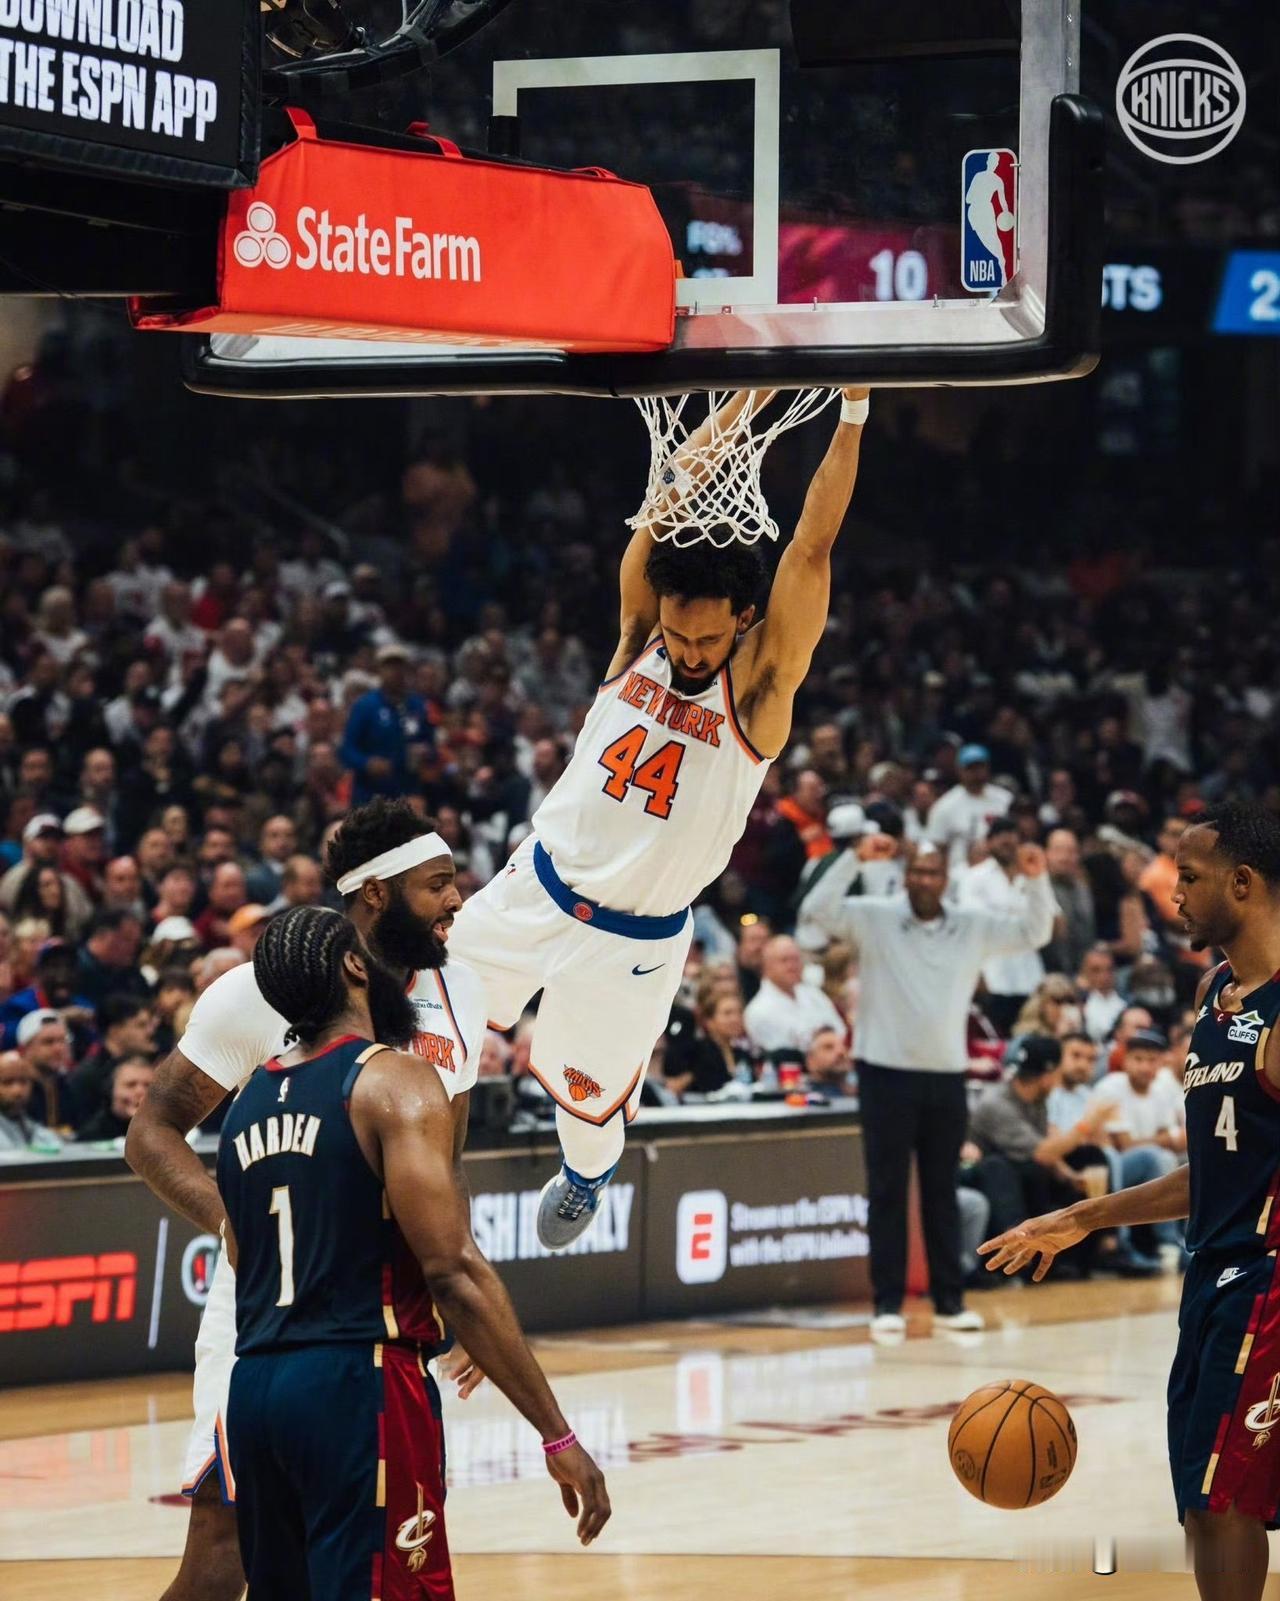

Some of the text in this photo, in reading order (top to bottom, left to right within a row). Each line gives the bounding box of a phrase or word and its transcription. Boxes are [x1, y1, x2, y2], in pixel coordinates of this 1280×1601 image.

[0, 0, 184, 62] DOWNLOAD
[0, 37, 217, 142] THE ESPN APP
[869, 249, 928, 301] 10
[970, 259, 995, 282] NBA
[1101, 263, 1163, 312] TS
[598, 724, 686, 820] 44
[1229, 1028, 1257, 1042] CLIFFS
[232, 1113, 321, 1172] HARDEN
[1215, 1095, 1239, 1152] 4
[269, 1185, 295, 1307] 1
